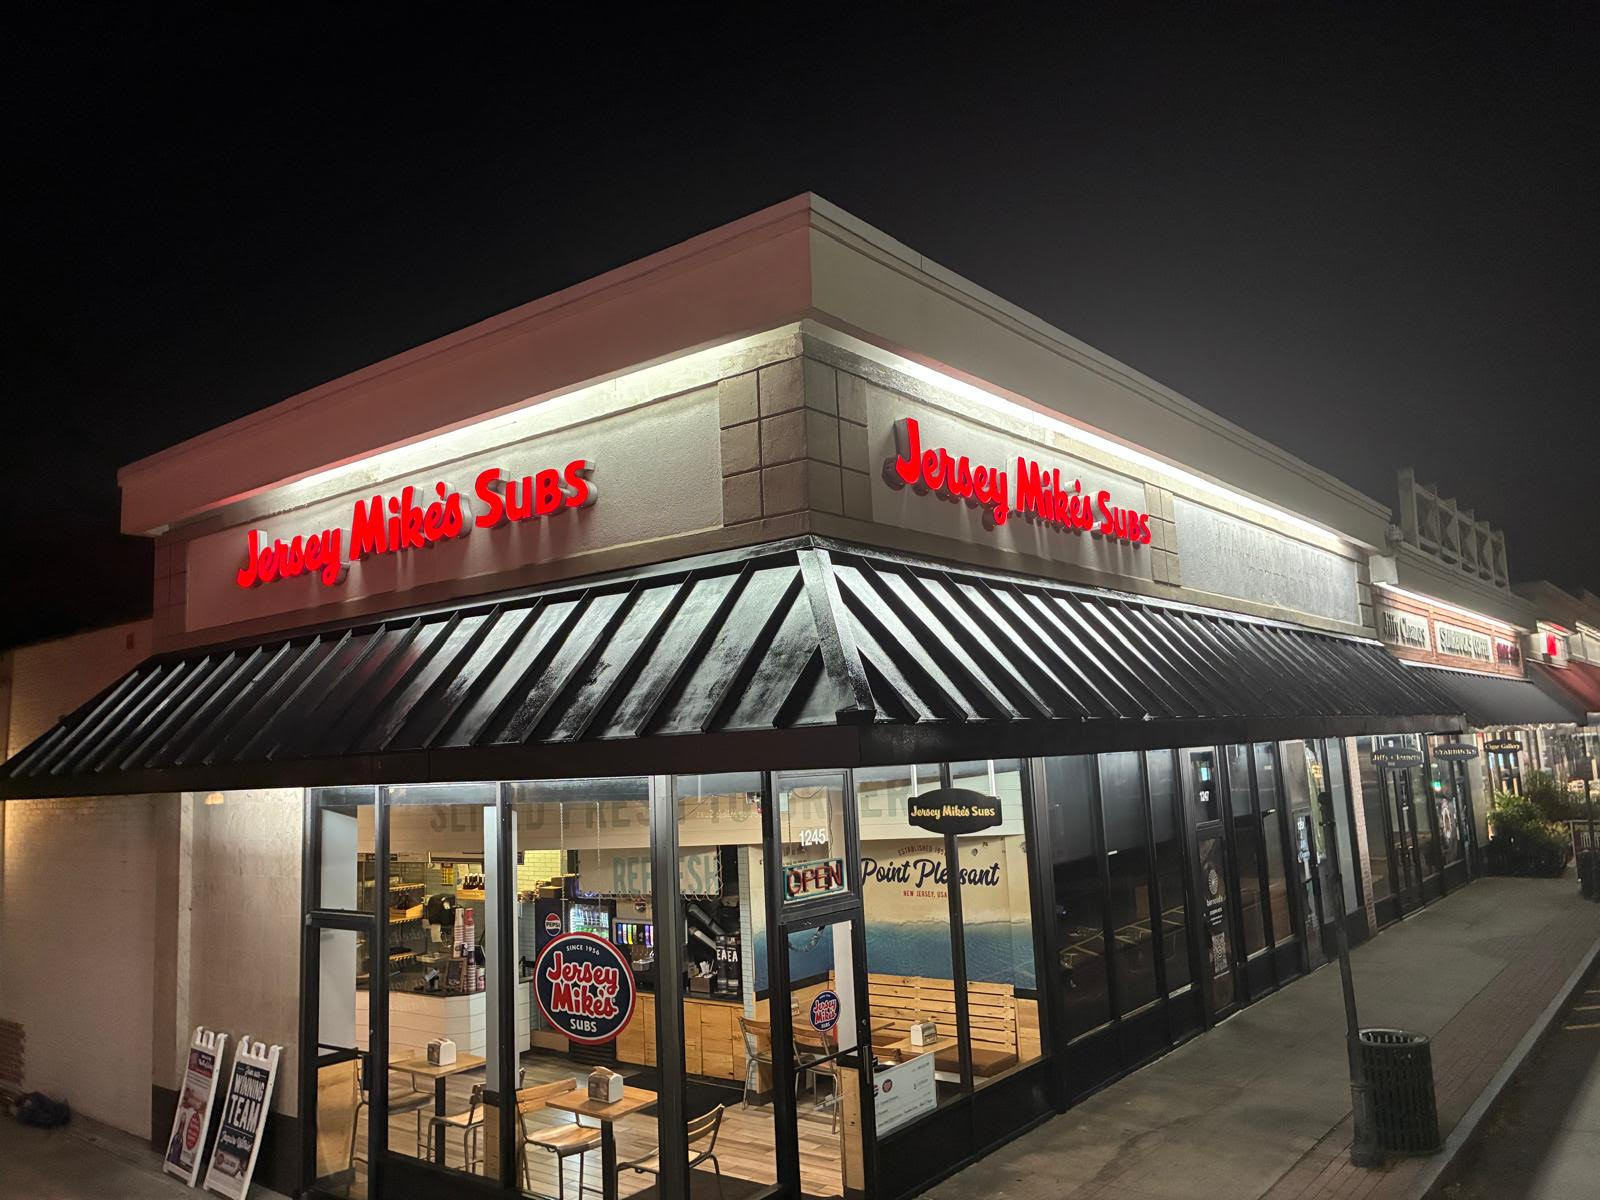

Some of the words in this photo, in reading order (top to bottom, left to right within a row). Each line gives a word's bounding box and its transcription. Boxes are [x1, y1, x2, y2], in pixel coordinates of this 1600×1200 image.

[895, 417, 1009, 526] Jersey
[1016, 457, 1093, 531] Mike's
[237, 528, 342, 588] Jersey
[350, 481, 464, 561] Mike's
[911, 805, 941, 819] Jersey
[942, 805, 970, 817] Mike's
[800, 828, 826, 846] 1245
[898, 845, 933, 856] ESTABLISHED
[934, 846, 947, 856] 195
[613, 856, 719, 893] REFSH
[787, 864, 842, 894] OPEN
[861, 857, 911, 886] Point
[913, 858, 1000, 888] Plesant
[916, 890, 936, 898] JERSEY,
[546, 921, 560, 929] PEPSI
[566, 944, 583, 952] SINCE
[585, 945, 600, 955] 1956
[546, 951, 619, 996] Jersey
[551, 981, 619, 1019] Mike's
[813, 999, 837, 1013] Jersey
[570, 1018, 597, 1032] SUBS
[233, 1073, 265, 1102] WINNING
[228, 1094, 261, 1134] TEAM
